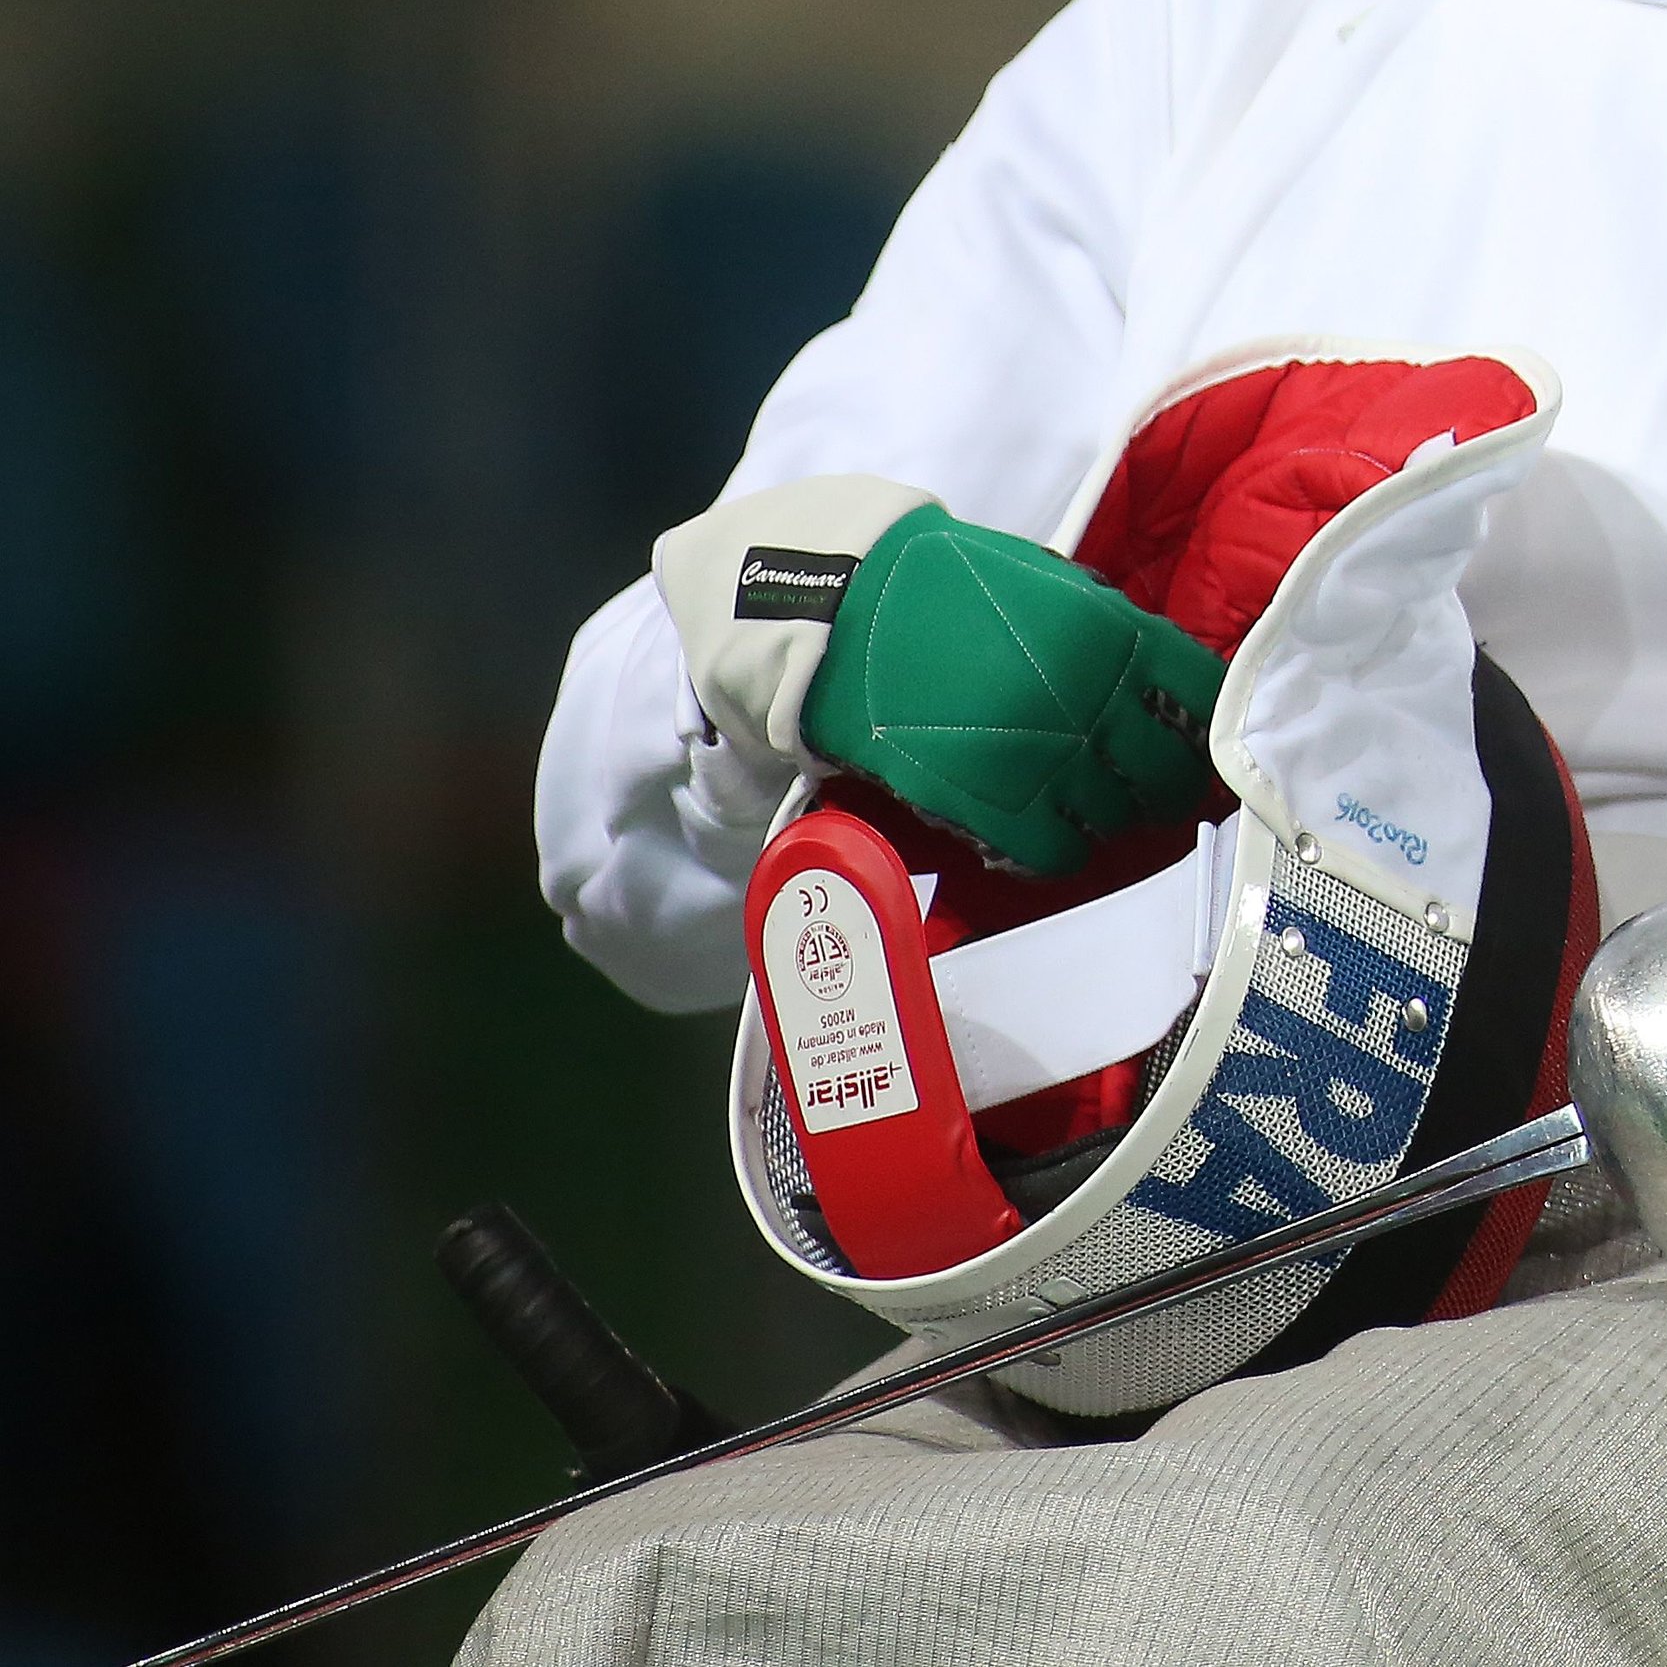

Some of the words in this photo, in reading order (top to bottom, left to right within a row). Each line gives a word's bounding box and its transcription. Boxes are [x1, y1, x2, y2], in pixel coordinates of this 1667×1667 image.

[741, 559, 848, 588] Carmimari
[820, 1007, 855, 1029] M2005
[858, 1020, 886, 1038] Made
[797, 1029, 845, 1050] Germany
[847, 1025, 859, 1040] in
[810, 1041, 883, 1068] www.allstar.de
[807, 1067, 890, 1109] allstar
[1125, 891, 1456, 1272] FRA
